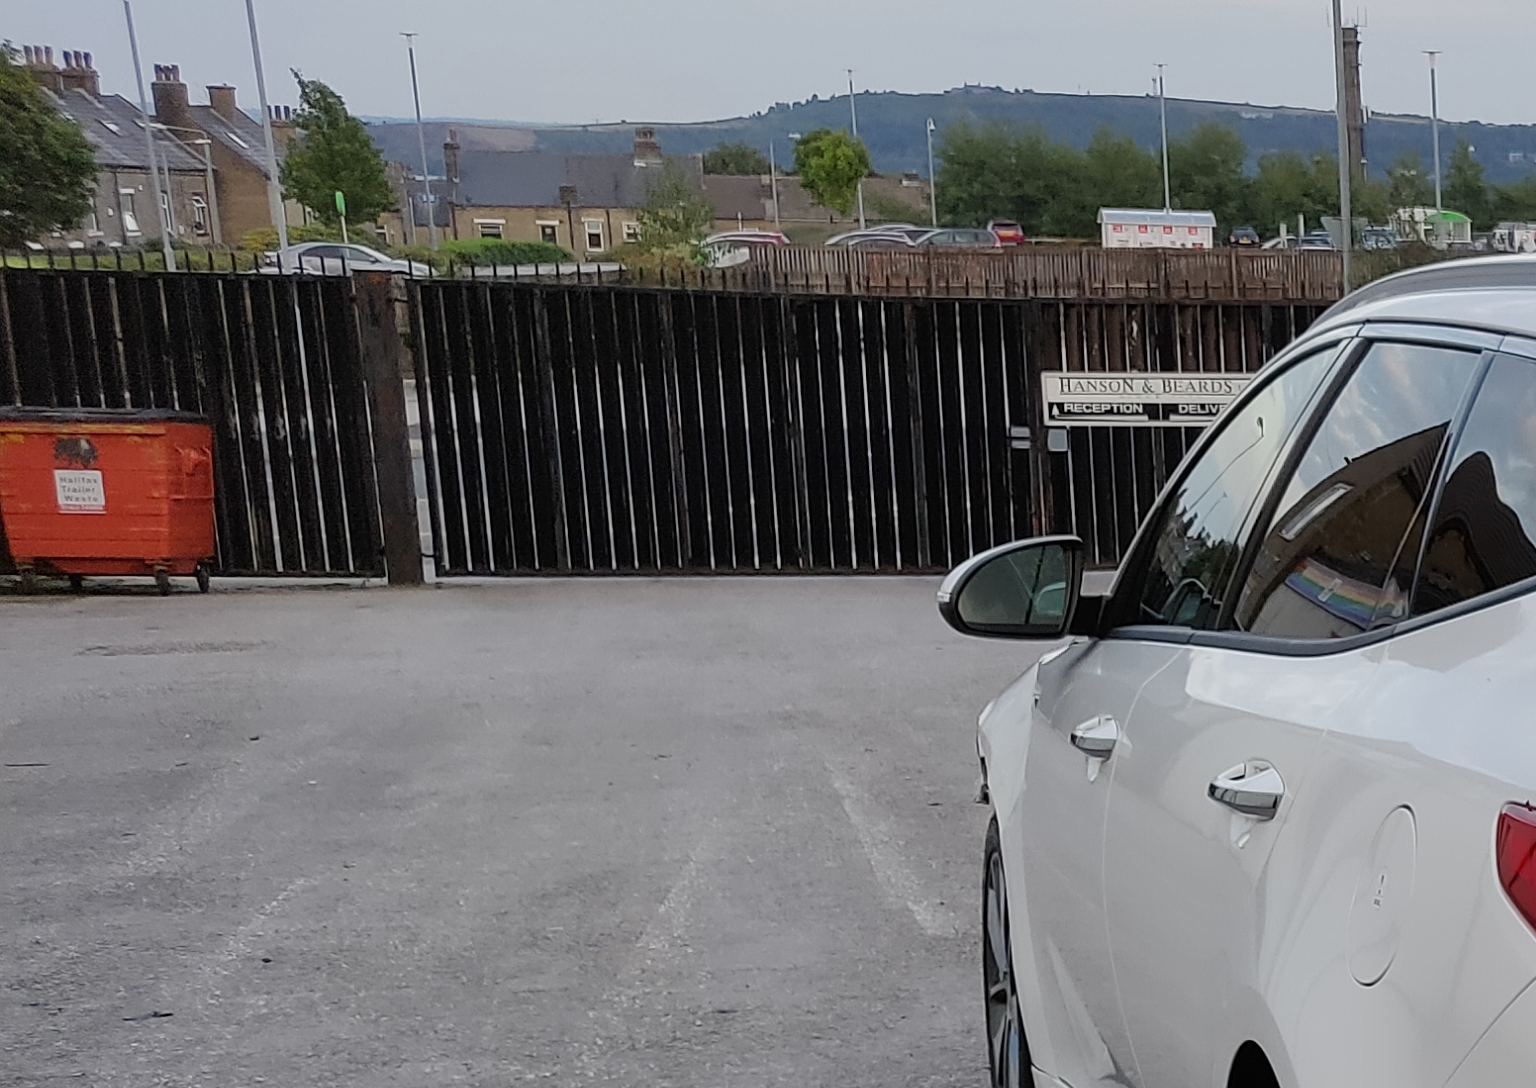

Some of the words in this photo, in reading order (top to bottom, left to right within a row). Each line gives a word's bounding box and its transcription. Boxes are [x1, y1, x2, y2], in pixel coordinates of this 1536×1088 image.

[1059, 378, 1135, 393] HANSON
[1141, 378, 1155, 394] &
[1161, 378, 1233, 394] BEARDS
[1063, 403, 1144, 414] RECEPTION
